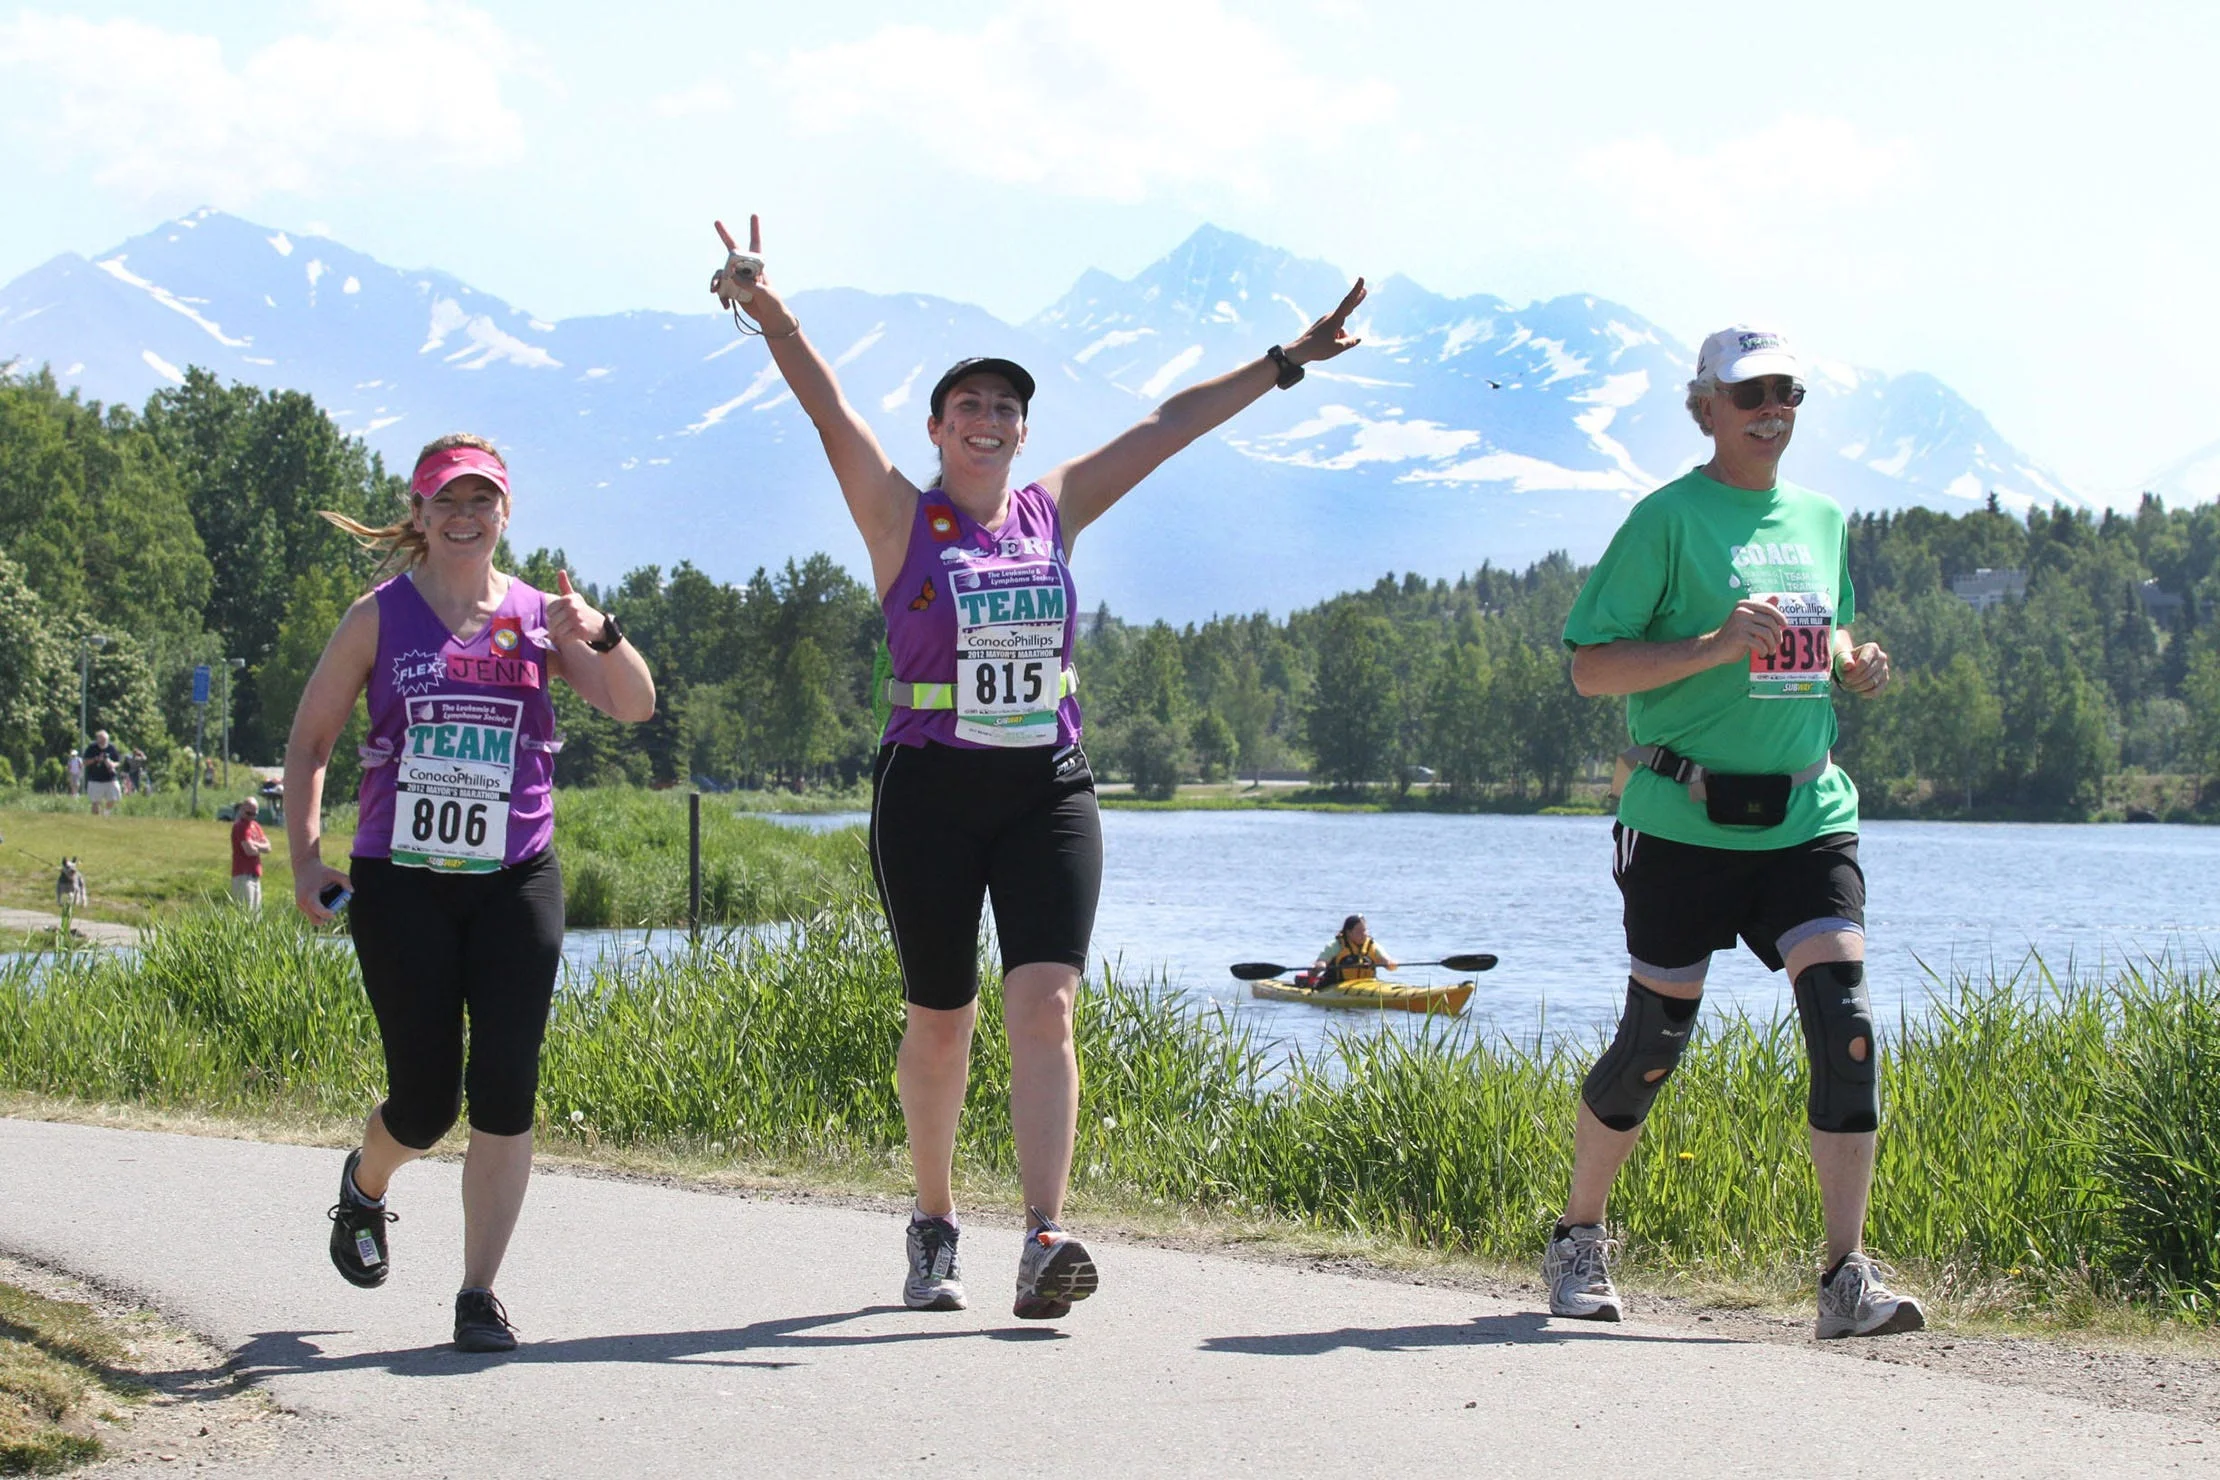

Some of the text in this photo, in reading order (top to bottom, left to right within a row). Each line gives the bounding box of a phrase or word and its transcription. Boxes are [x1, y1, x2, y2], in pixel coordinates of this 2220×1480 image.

[1731, 543, 1814, 567] COACH
[991, 577, 1030, 585] Lymphoma
[1001, 569, 1035, 578] Leukemia
[958, 588, 1064, 625] TEAM
[1779, 603, 1827, 616] ocoPhillips
[968, 635, 1053, 648] ConocoPhillips
[968, 649, 1054, 659] 2012 MAYOR'S MARATHON
[400, 662, 439, 681] FLEX
[453, 657, 537, 682] JENN
[976, 662, 1042, 705] 815
[1782, 682, 1813, 692] SUBWAY
[442, 704, 454, 712] The
[456, 704, 489, 713] Leukemia
[443, 712, 507, 724] Lymphoma Society
[408, 724, 513, 764] TEAM
[409, 768, 500, 789] ConocoPhillips
[407, 783, 500, 800] 2012 MAYOR'S MARATHON
[412, 798, 488, 847] 806
